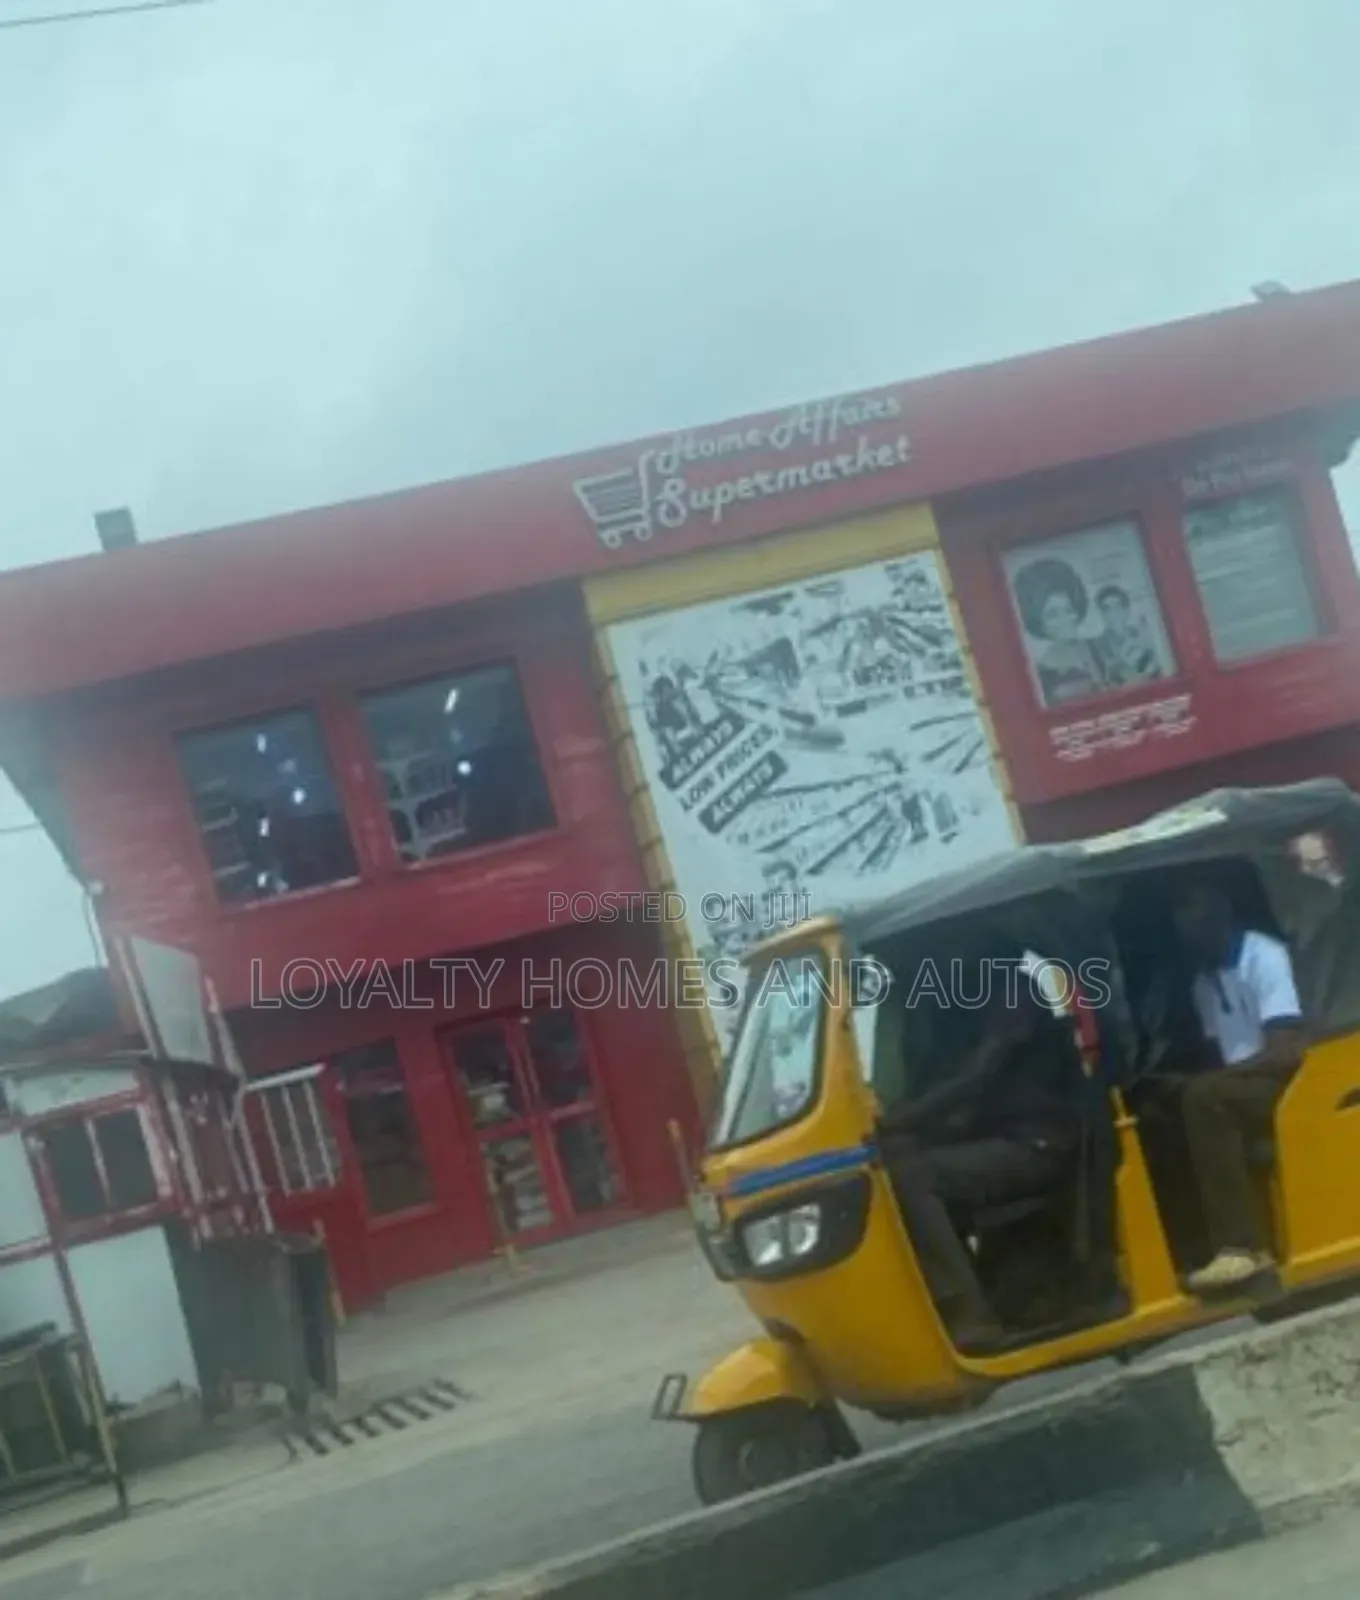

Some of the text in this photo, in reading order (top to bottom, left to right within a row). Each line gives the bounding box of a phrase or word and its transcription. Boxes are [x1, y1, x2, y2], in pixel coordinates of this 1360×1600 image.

[656, 396, 900, 474] Home Affairs
[655, 435, 912, 527] Supermarket
